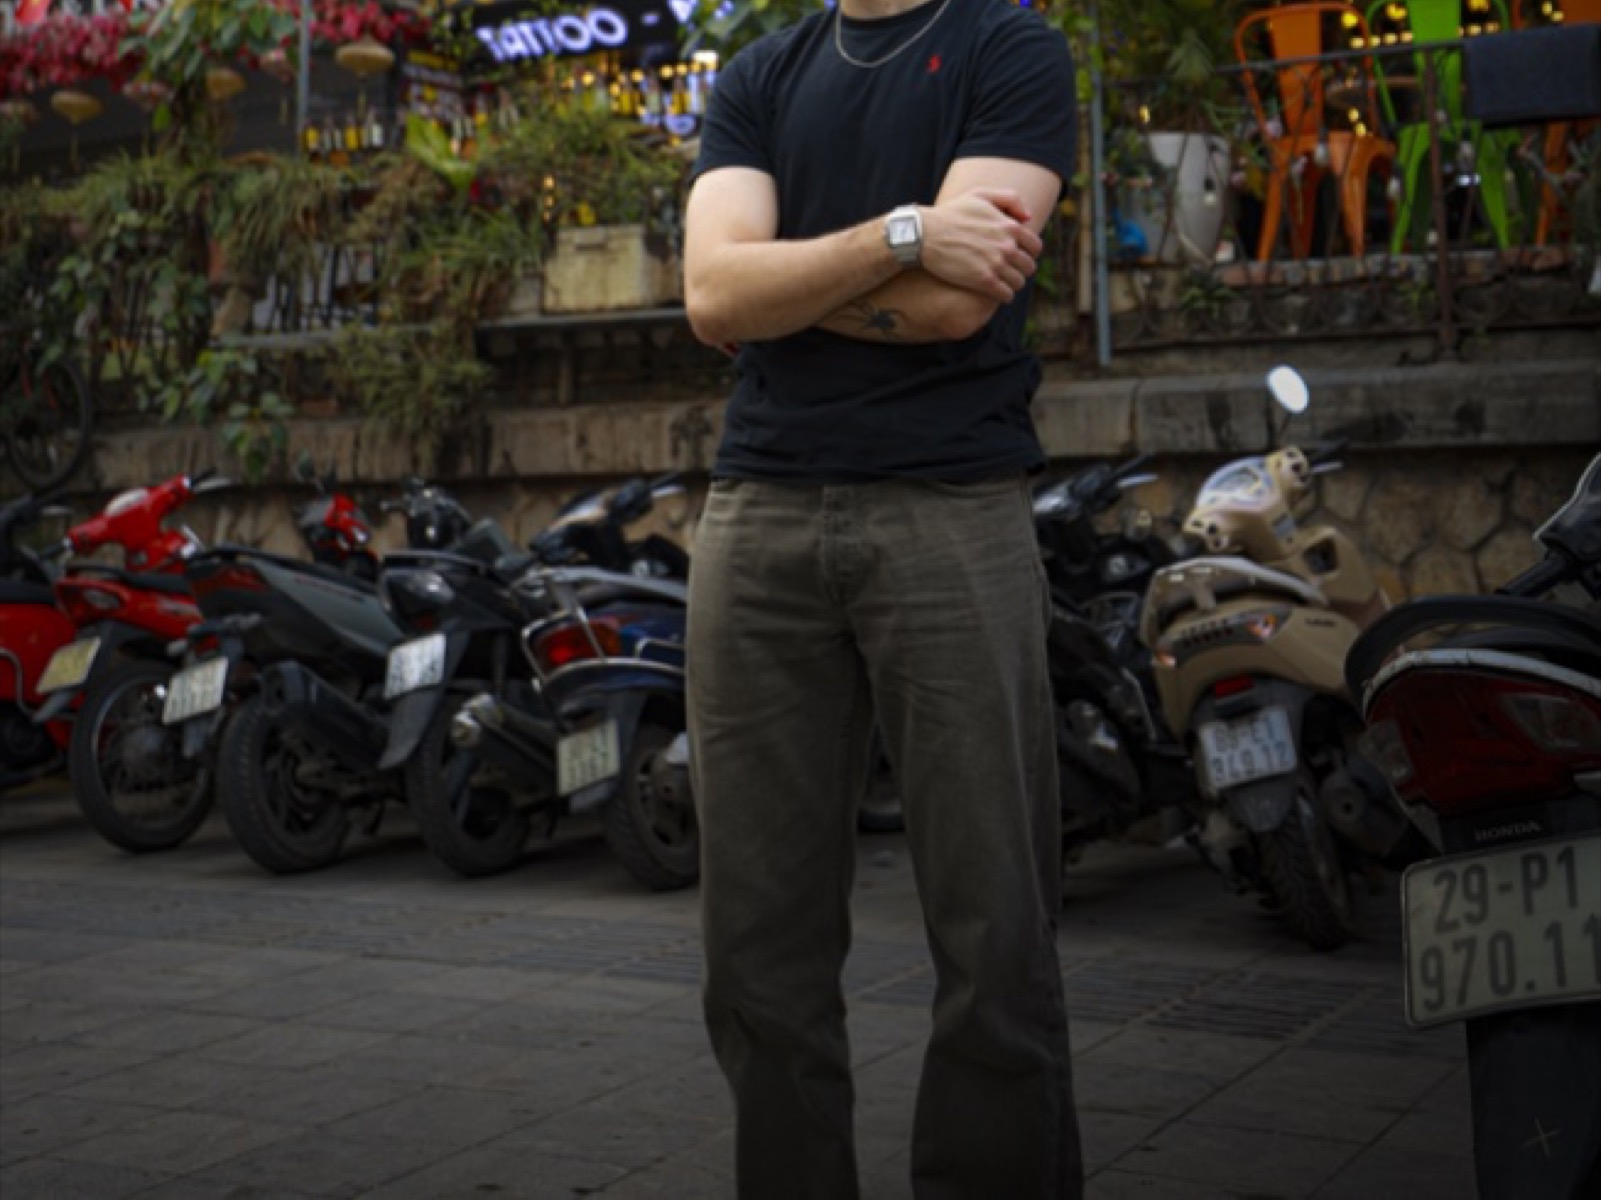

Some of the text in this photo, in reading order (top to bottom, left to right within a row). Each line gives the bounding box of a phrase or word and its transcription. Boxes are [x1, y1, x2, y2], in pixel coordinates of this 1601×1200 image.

[1474, 819, 1542, 841] HONDA
[1432, 845, 1578, 934] 29-P1
[1419, 912, 1601, 1011] 970.11
